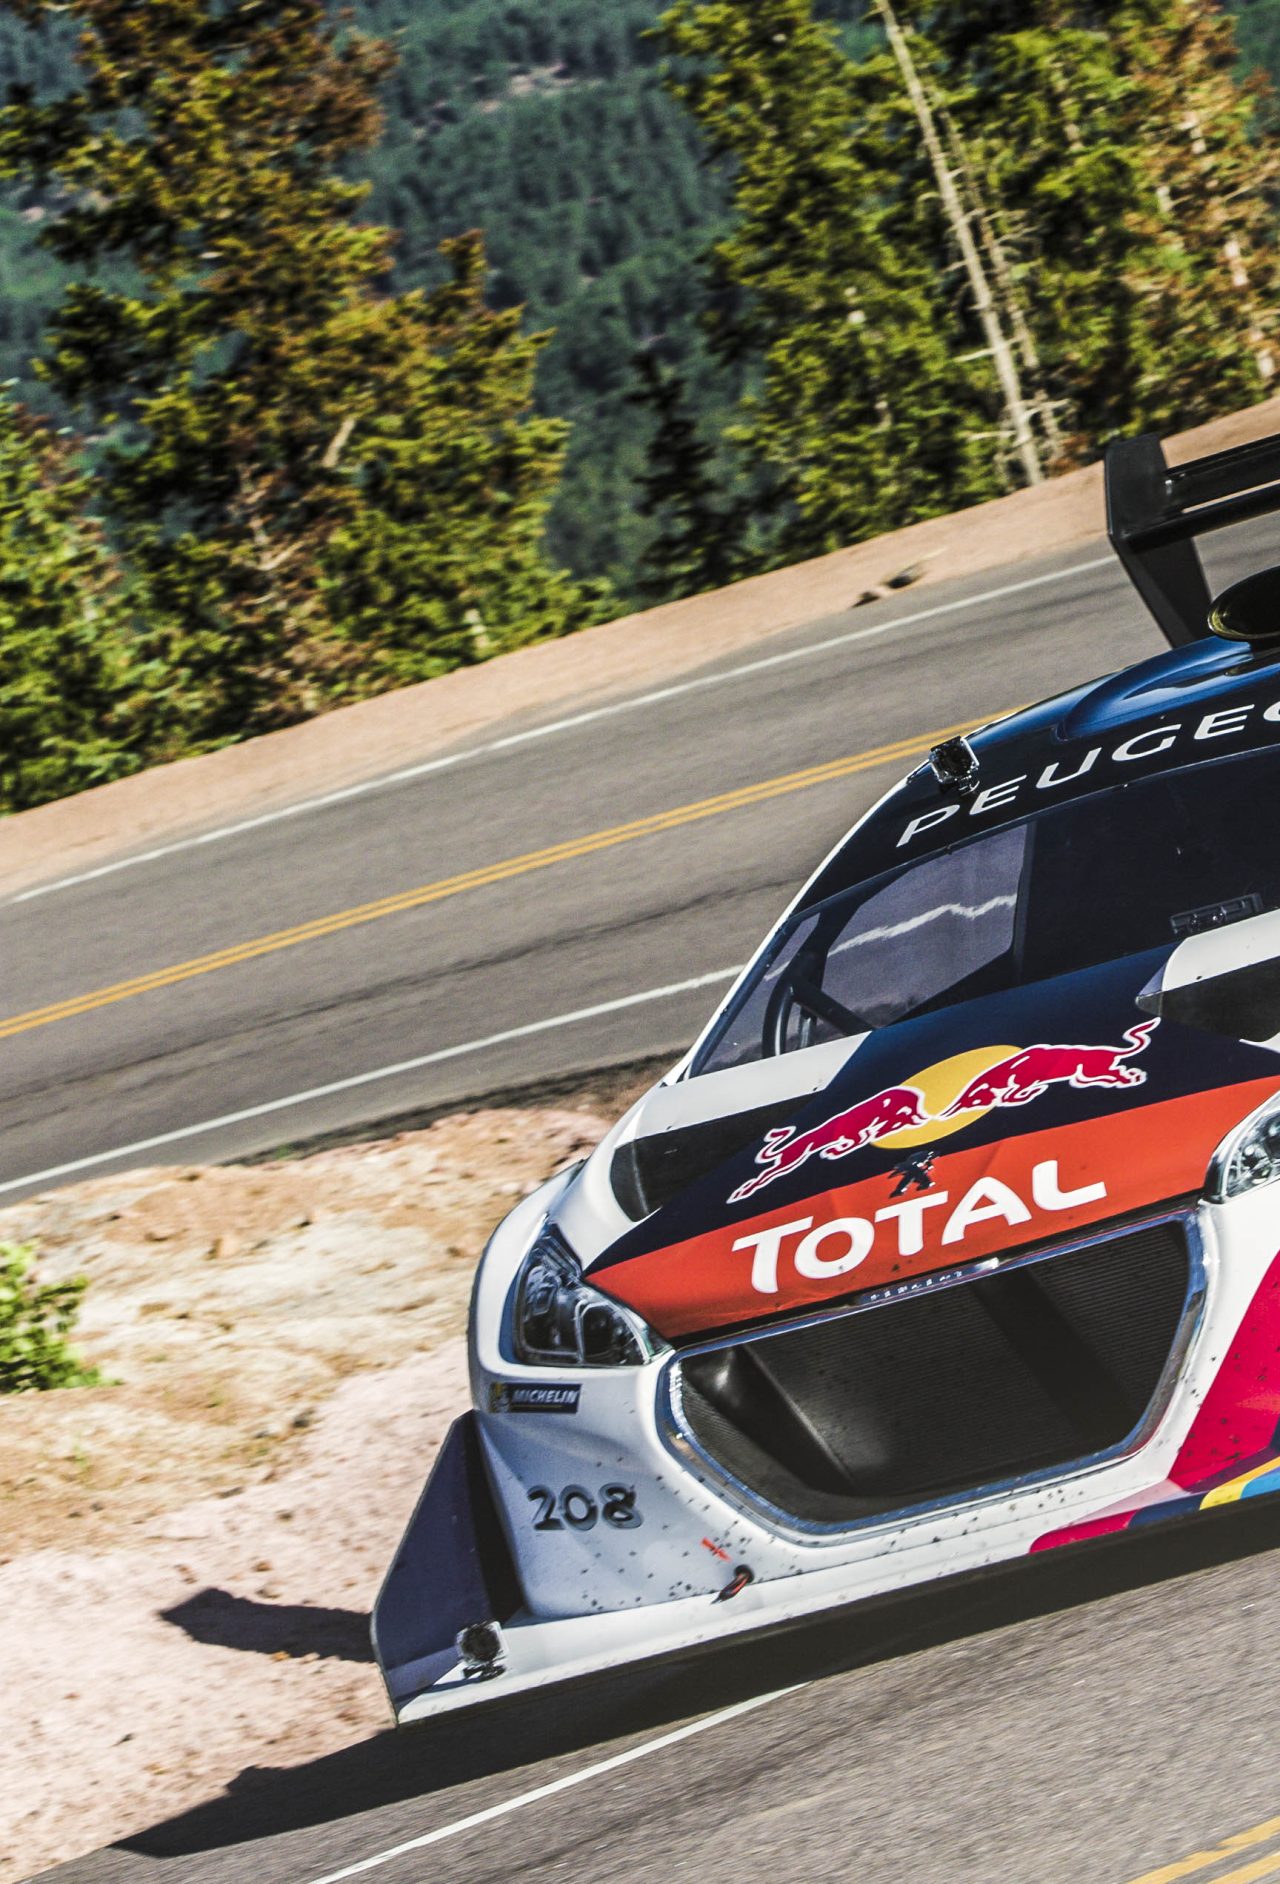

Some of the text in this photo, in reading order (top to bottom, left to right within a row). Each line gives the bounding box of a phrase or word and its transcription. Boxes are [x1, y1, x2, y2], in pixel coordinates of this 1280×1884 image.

[731, 1159, 1107, 1294] TOTAL
[513, 1388, 580, 1404] MICHELIN
[526, 1482, 644, 1532] 208
